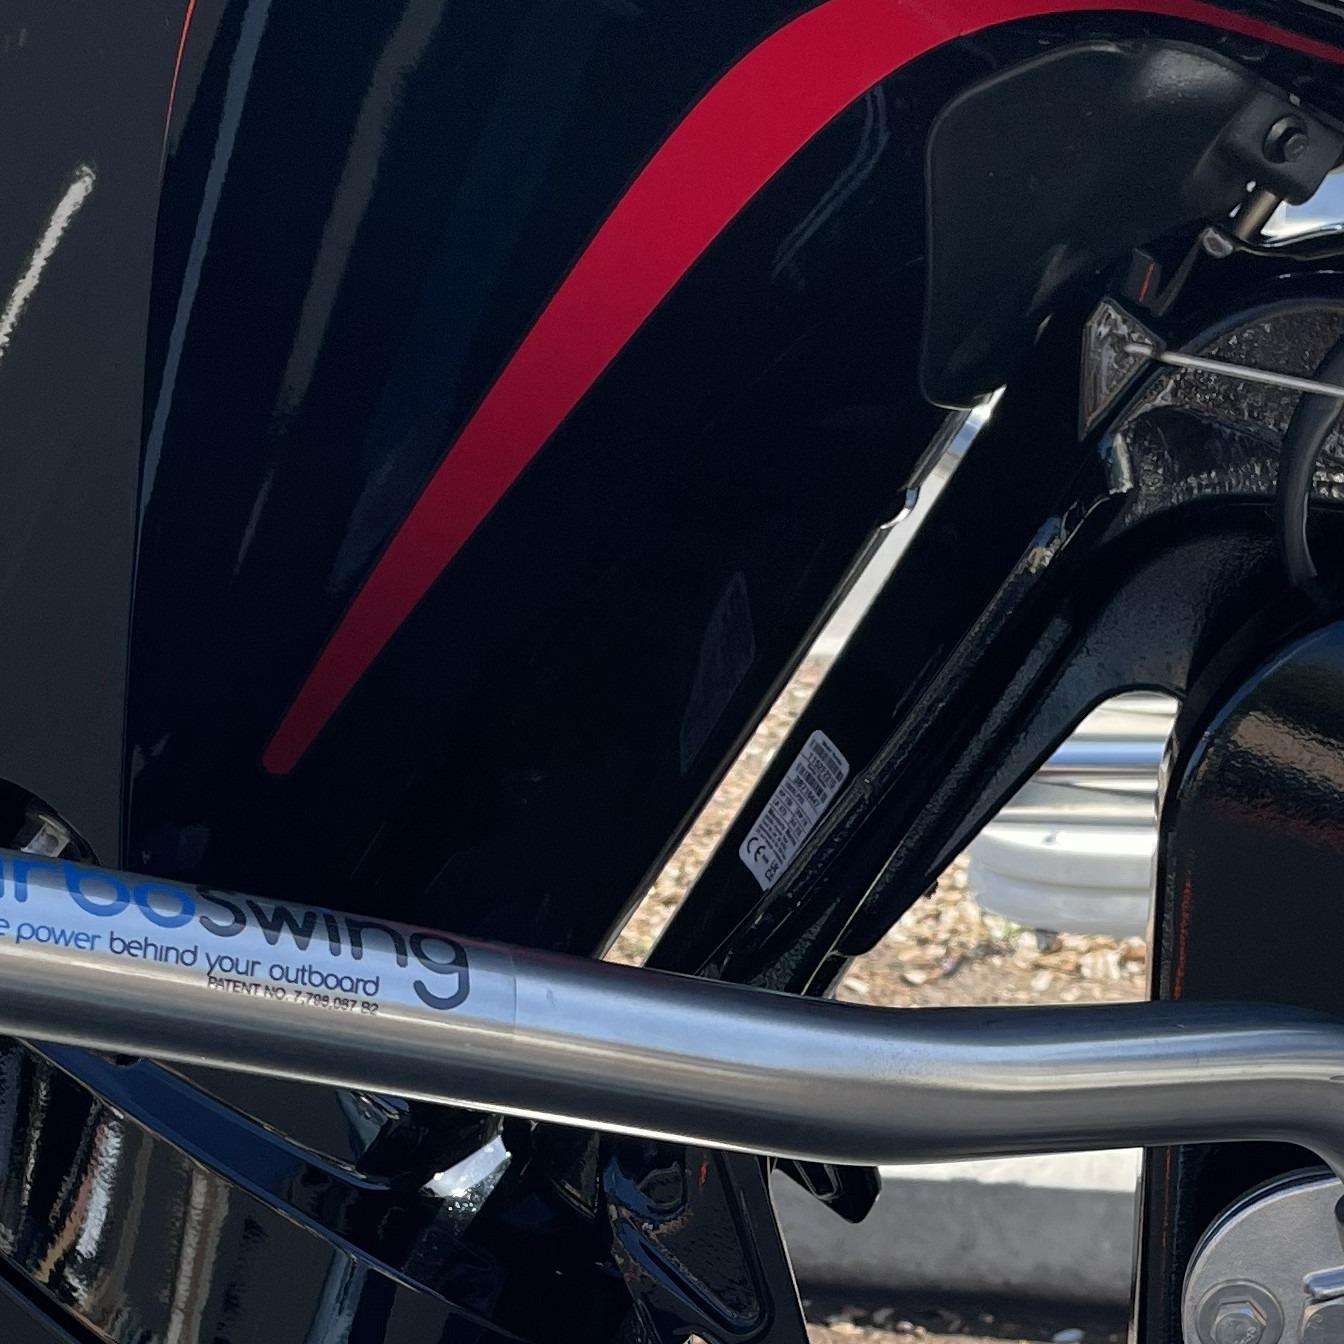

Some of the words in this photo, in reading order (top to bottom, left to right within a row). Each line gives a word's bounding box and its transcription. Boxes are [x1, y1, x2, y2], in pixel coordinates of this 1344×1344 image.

[15, 921, 102, 951] power
[109, 930, 198, 967] behind
[205, 952, 262, 977] your
[268, 962, 380, 997] outboard
[207, 975, 262, 996] PATENT
